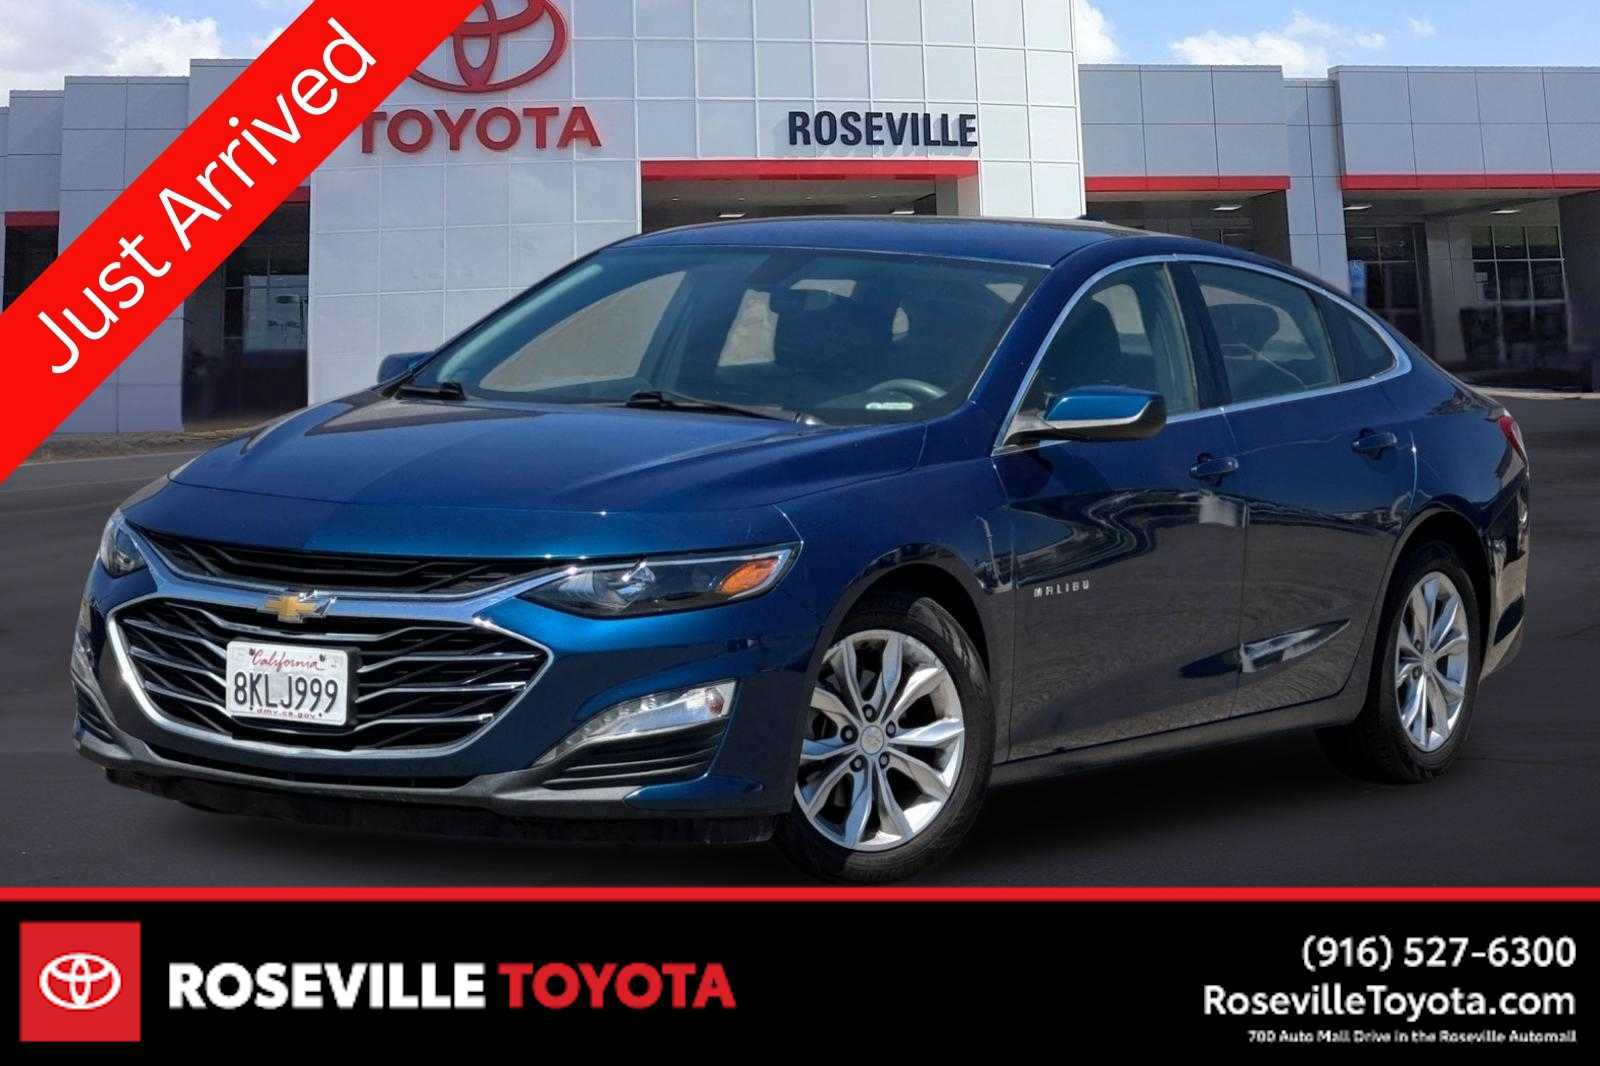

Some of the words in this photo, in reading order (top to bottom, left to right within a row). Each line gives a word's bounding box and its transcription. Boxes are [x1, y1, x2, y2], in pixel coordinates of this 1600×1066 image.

[361, 106, 601, 153] TOYOTA
[788, 111, 978, 147] ROSEVILLE
[1033, 579, 1091, 598] MALIBU
[250, 648, 325, 673] California
[234, 671, 339, 714] 8KLJ999
